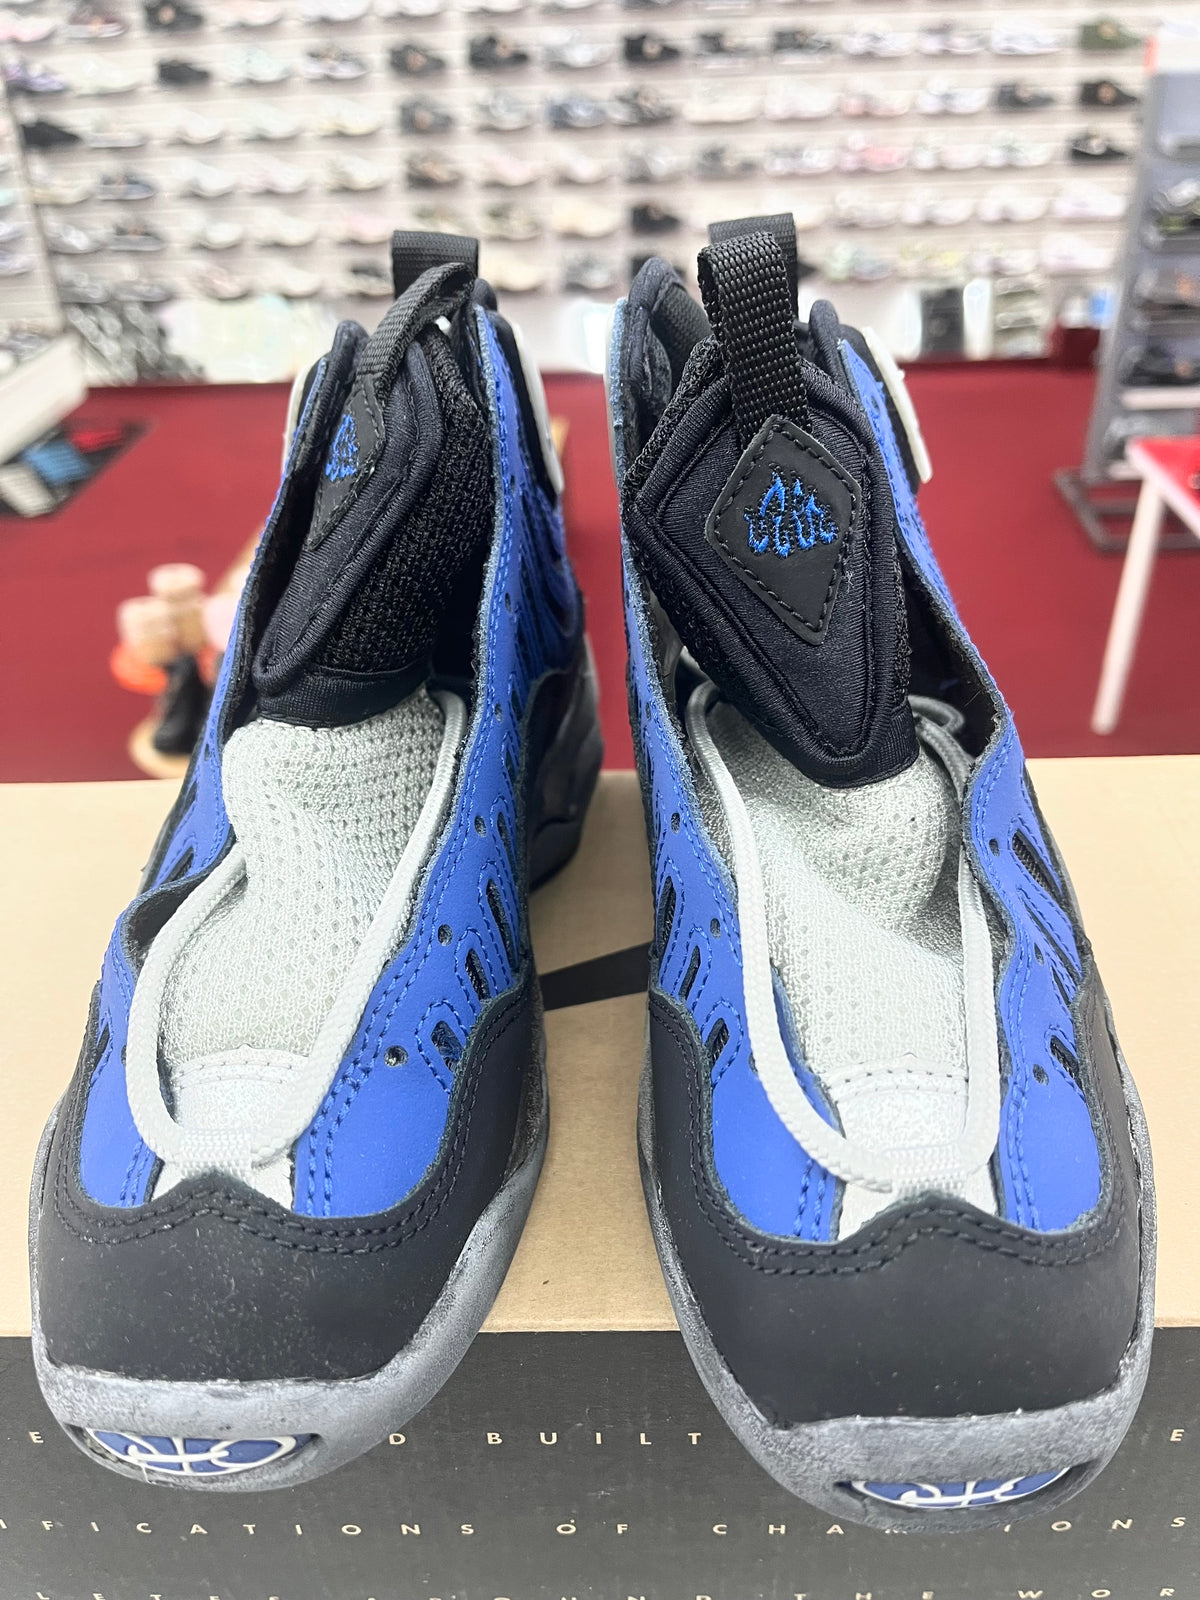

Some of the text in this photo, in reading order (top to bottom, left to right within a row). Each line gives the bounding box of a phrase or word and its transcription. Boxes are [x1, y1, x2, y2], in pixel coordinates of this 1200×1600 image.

[486, 1432, 702, 1445] BUILT
[556, 1523, 628, 1535] OF
[712, 1516, 1186, 1535] CHAIONS
[1017, 1587, 1175, 1599] WOR
